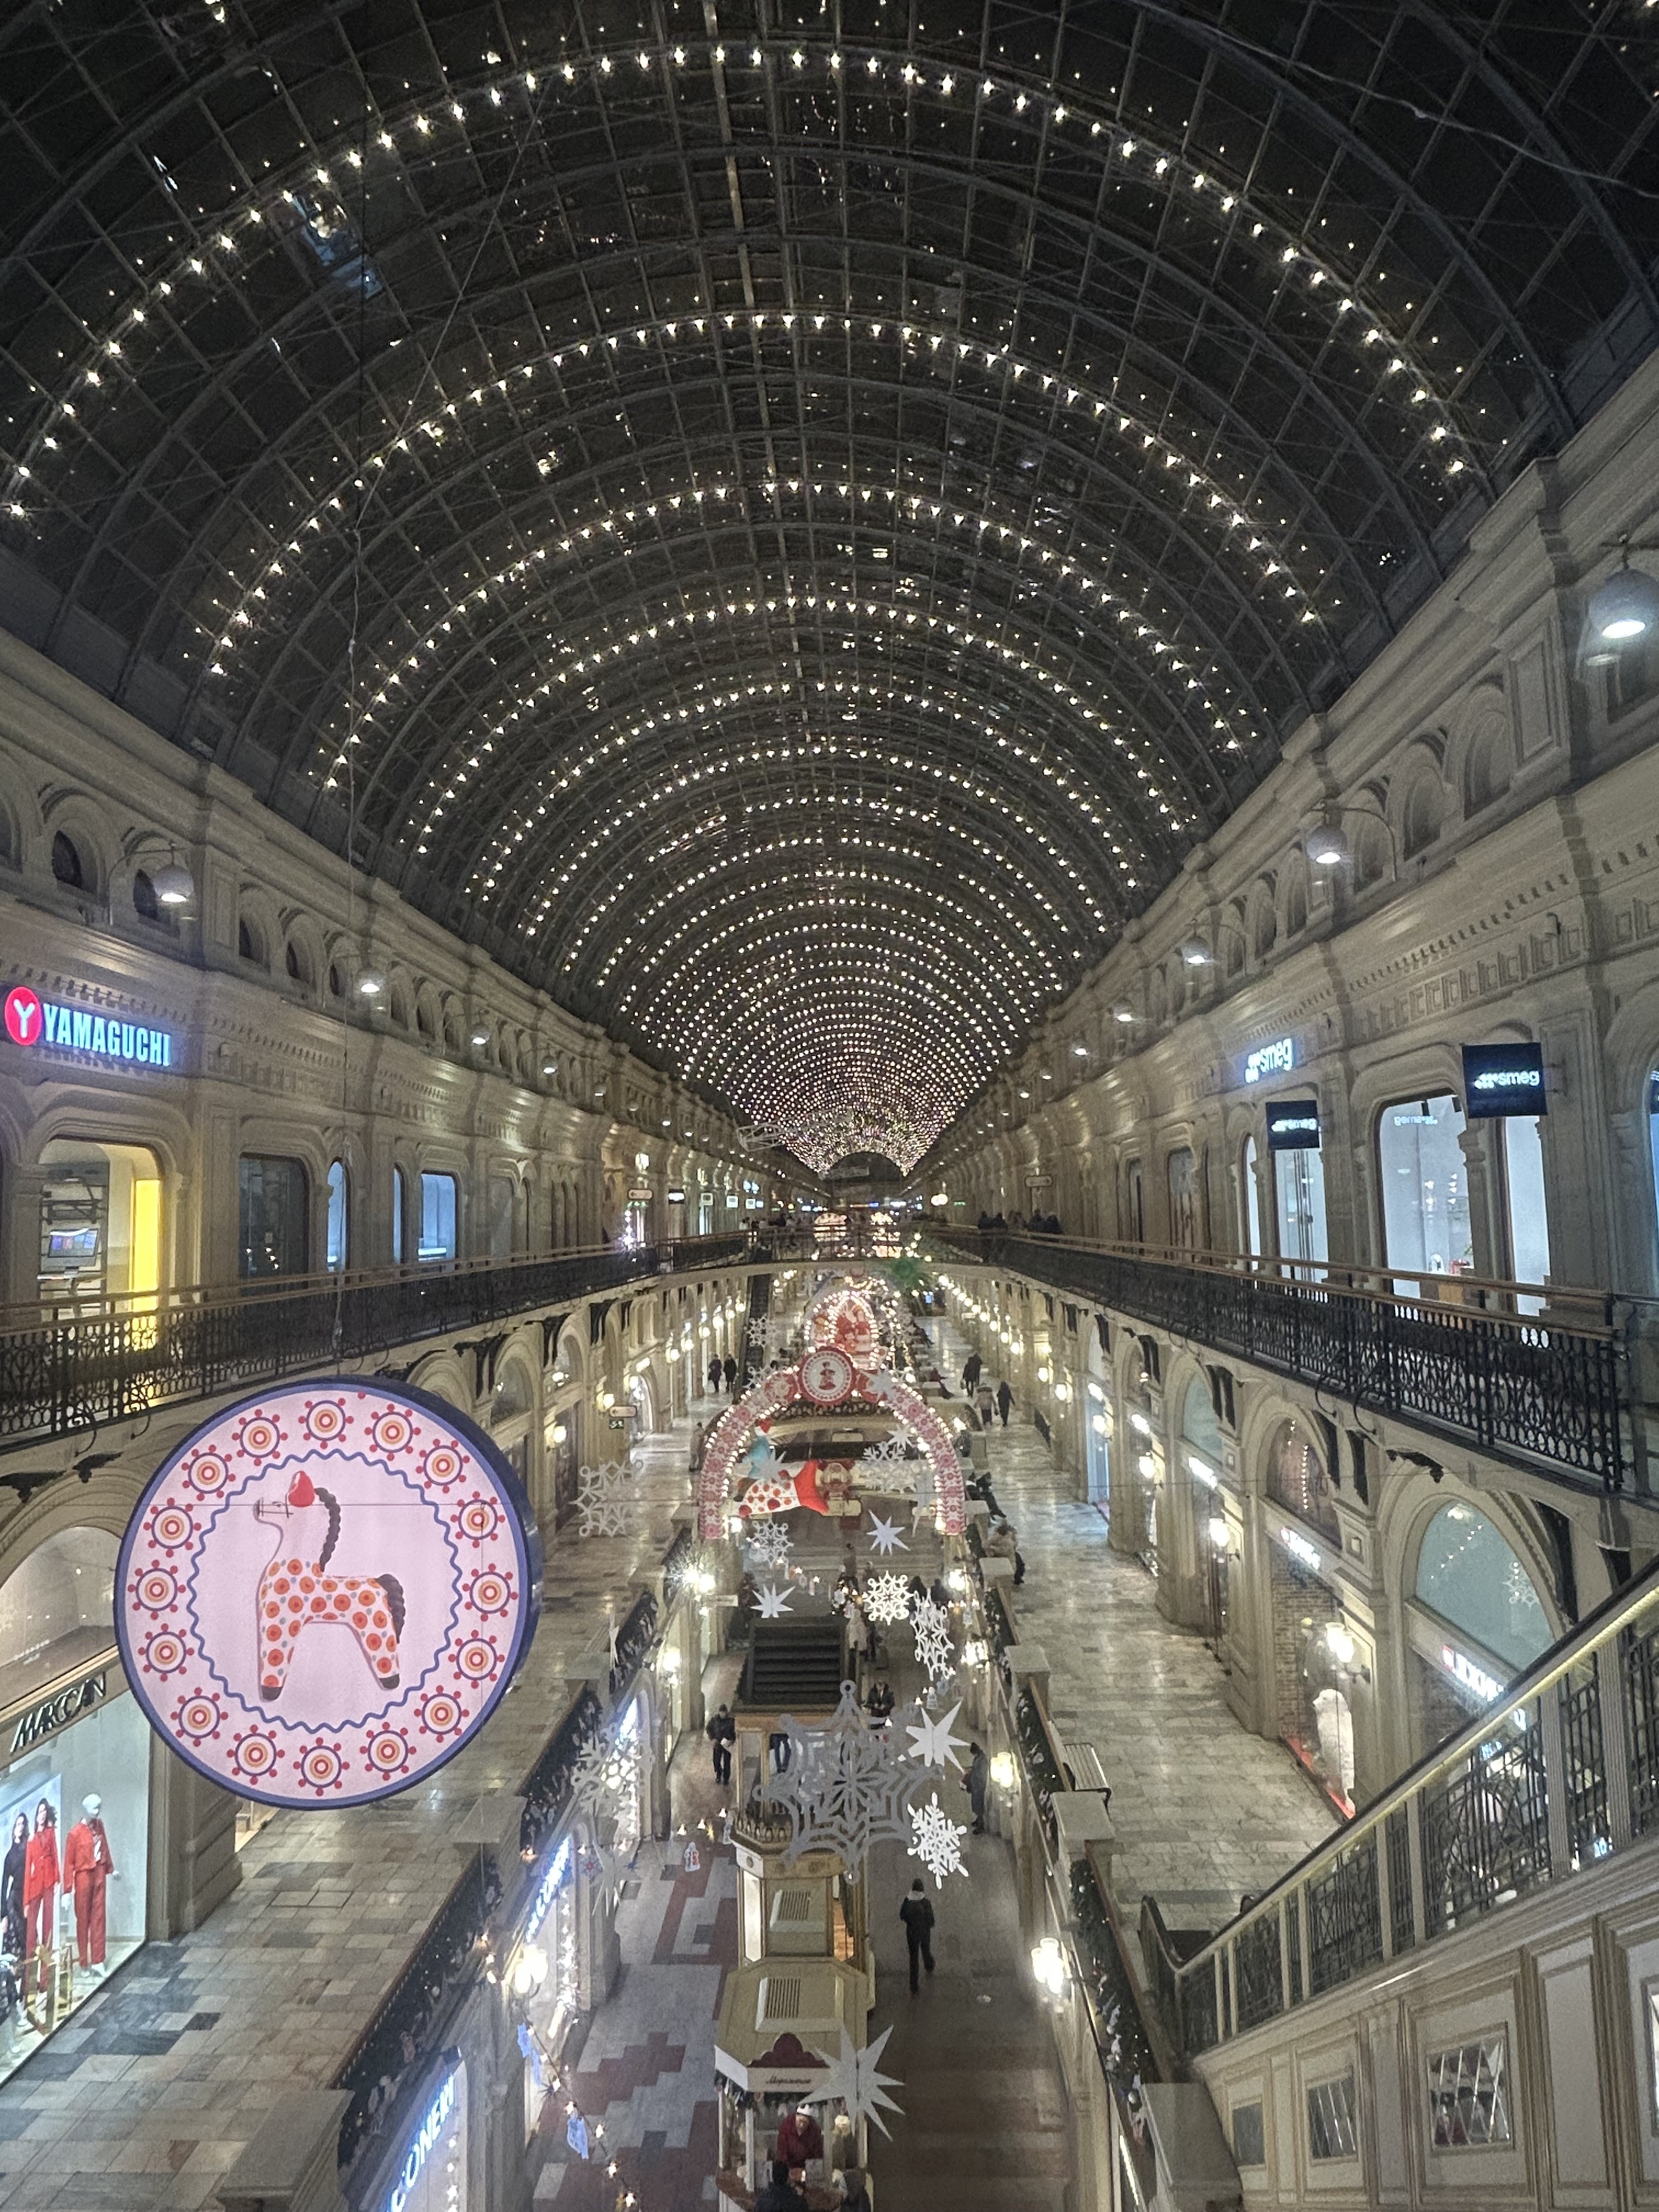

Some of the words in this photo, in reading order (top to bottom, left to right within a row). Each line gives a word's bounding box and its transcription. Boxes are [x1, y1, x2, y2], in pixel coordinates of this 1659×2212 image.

[13, 998, 35, 1038] Y
[43, 1002, 172, 1066] YAMAGUCHI
[1260, 1038, 1293, 1073] smeg
